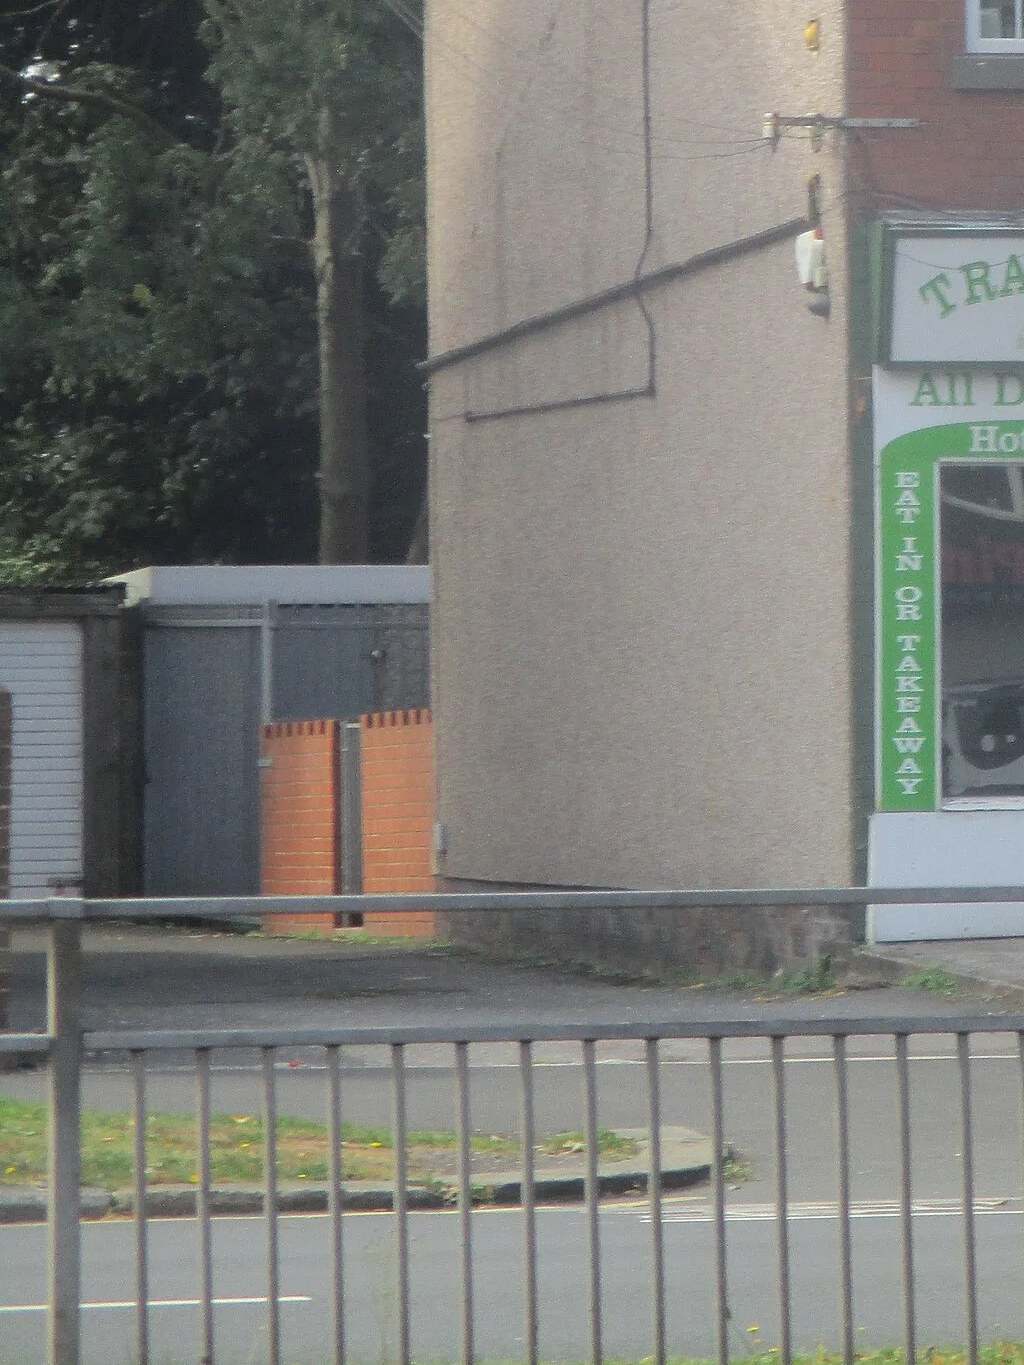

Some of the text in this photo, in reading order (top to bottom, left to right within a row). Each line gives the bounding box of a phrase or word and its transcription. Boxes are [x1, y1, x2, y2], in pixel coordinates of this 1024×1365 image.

[910, 372, 973, 408] All
[892, 471, 927, 795] EAT IN OR TAKEAWAY
